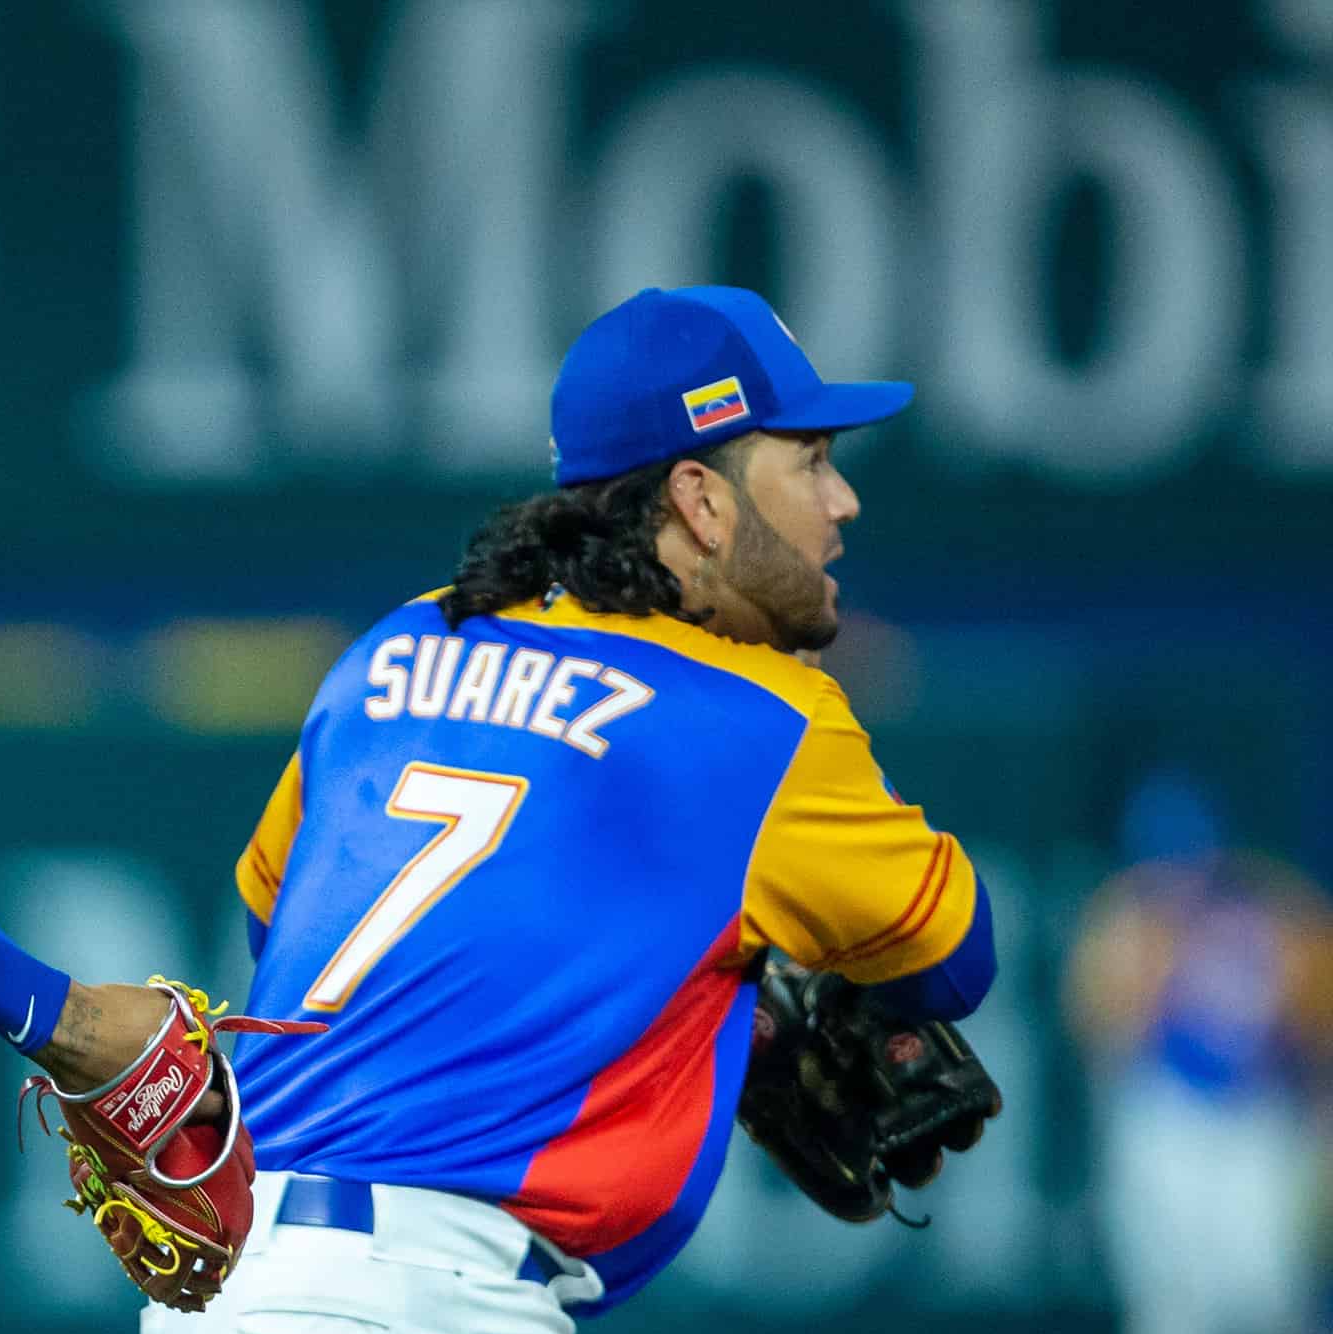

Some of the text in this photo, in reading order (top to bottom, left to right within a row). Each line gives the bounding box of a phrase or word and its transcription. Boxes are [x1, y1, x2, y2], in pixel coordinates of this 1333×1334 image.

[364, 634, 656, 760] SUAREZ
[301, 761, 530, 1013] 7
[128, 1065, 183, 1132] Rawlings
